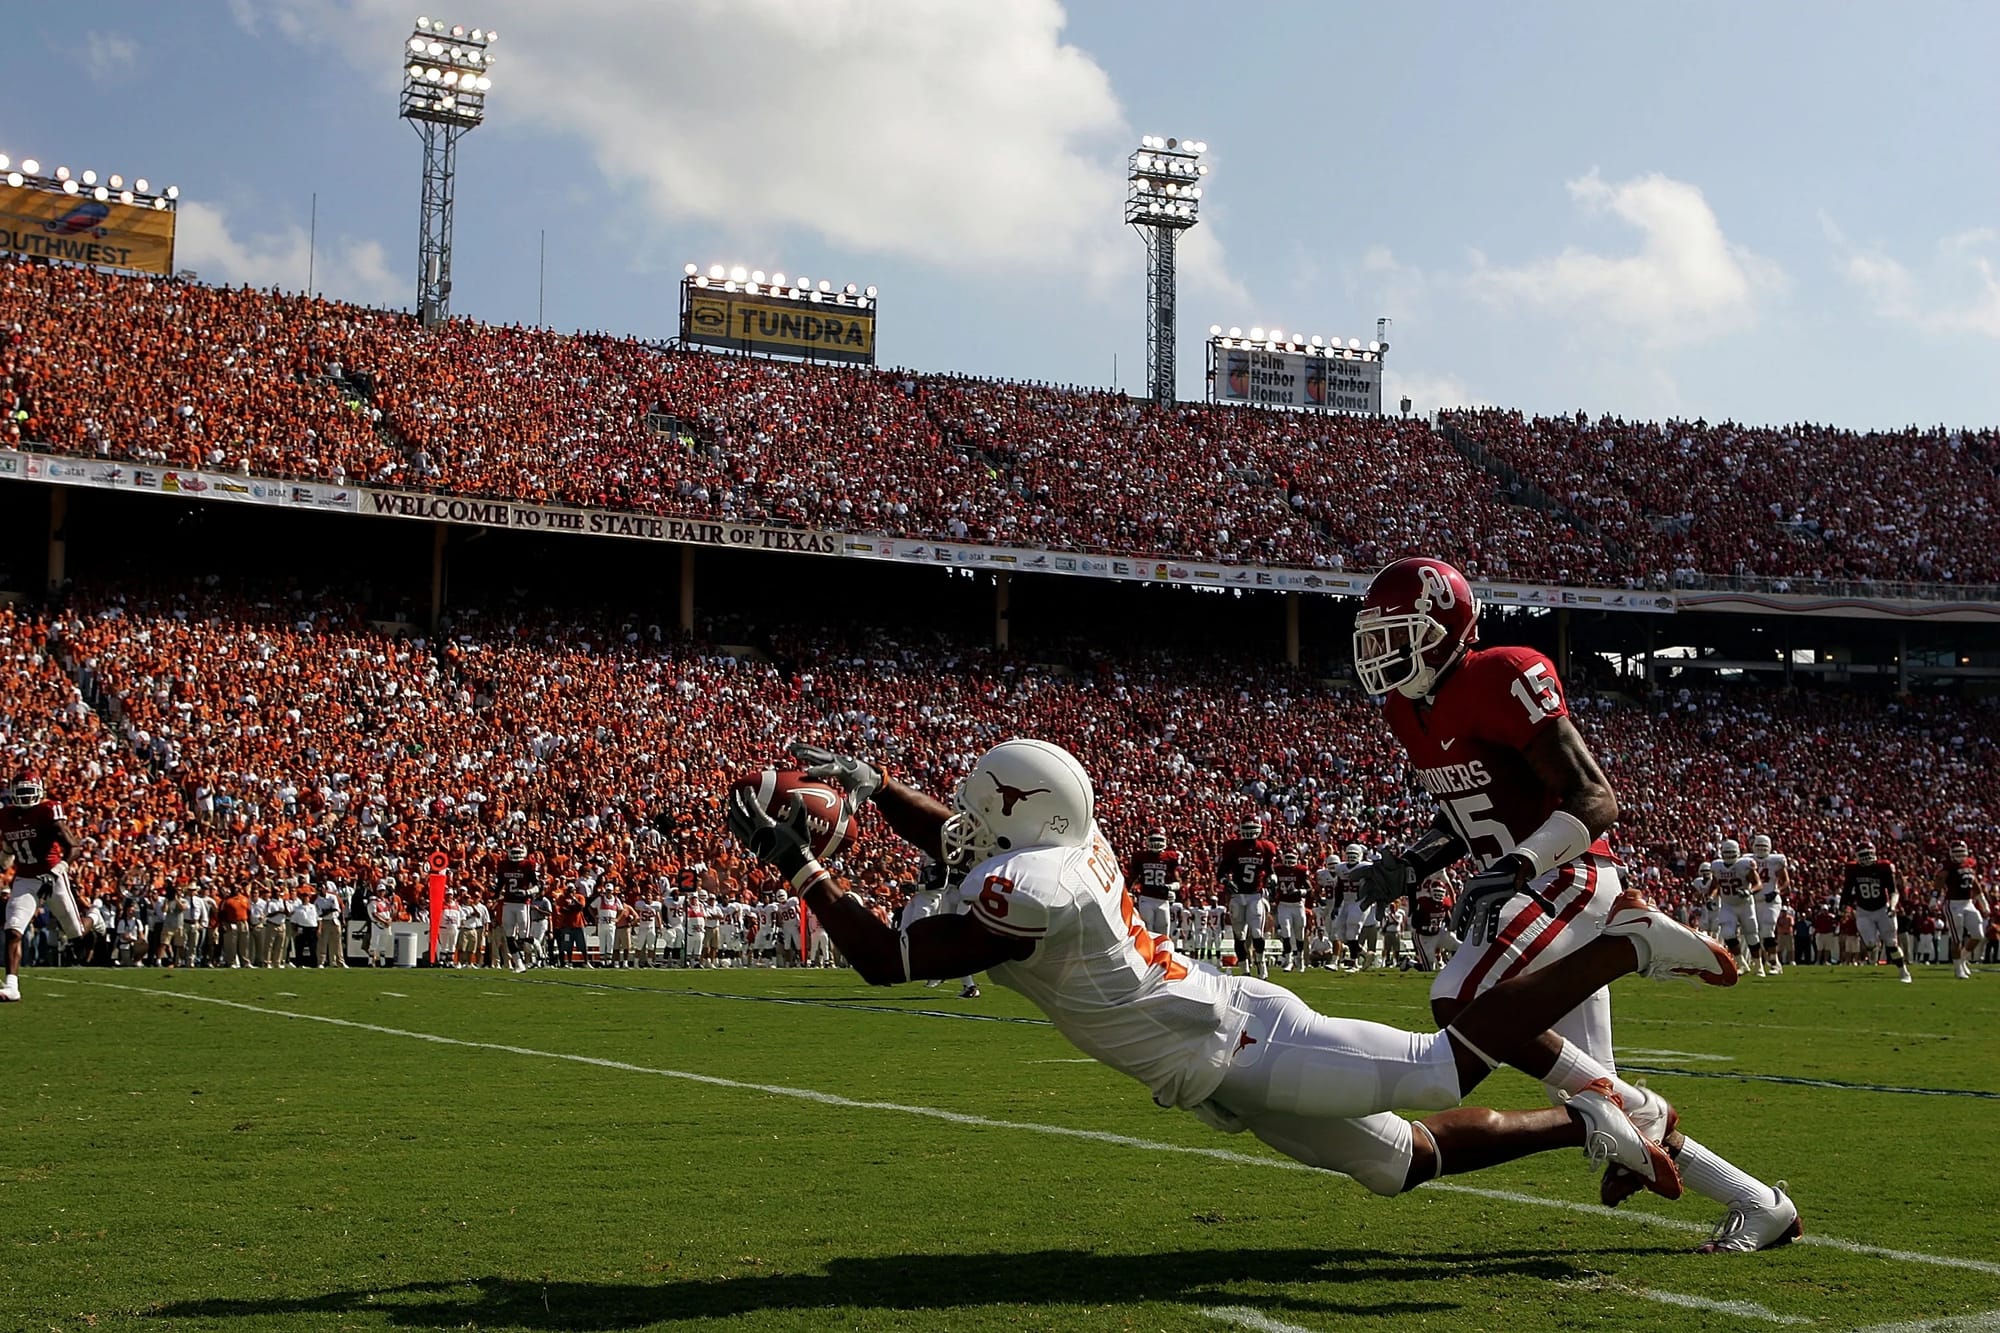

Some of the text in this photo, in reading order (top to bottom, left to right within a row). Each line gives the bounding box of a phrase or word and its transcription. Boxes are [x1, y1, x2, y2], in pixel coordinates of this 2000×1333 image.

[737, 308, 865, 347] TUNDRA
[1251, 351, 1285, 370] Palm
[1328, 359, 1361, 377] Palm
[1251, 368, 1295, 387] Harbor
[1328, 375, 1370, 394] Harbor
[1250, 385, 1294, 404] Homes
[1328, 391, 1369, 410] Homes
[371, 493, 835, 554] WELCOME TO THE STATE FAIR OF TEXAS
[1511, 661, 1560, 725] 15
[52, 801, 68, 820] 11
[1439, 793, 1516, 873] 15
[12, 840, 38, 865] 11
[681, 872, 695, 887] 2
[1144, 870, 1167, 886] 28
[1243, 865, 1256, 883] 5
[509, 879, 520, 892] 2
[1860, 883, 1880, 899] 86
[979, 875, 1014, 919] 6
[781, 908, 796, 920] 88
